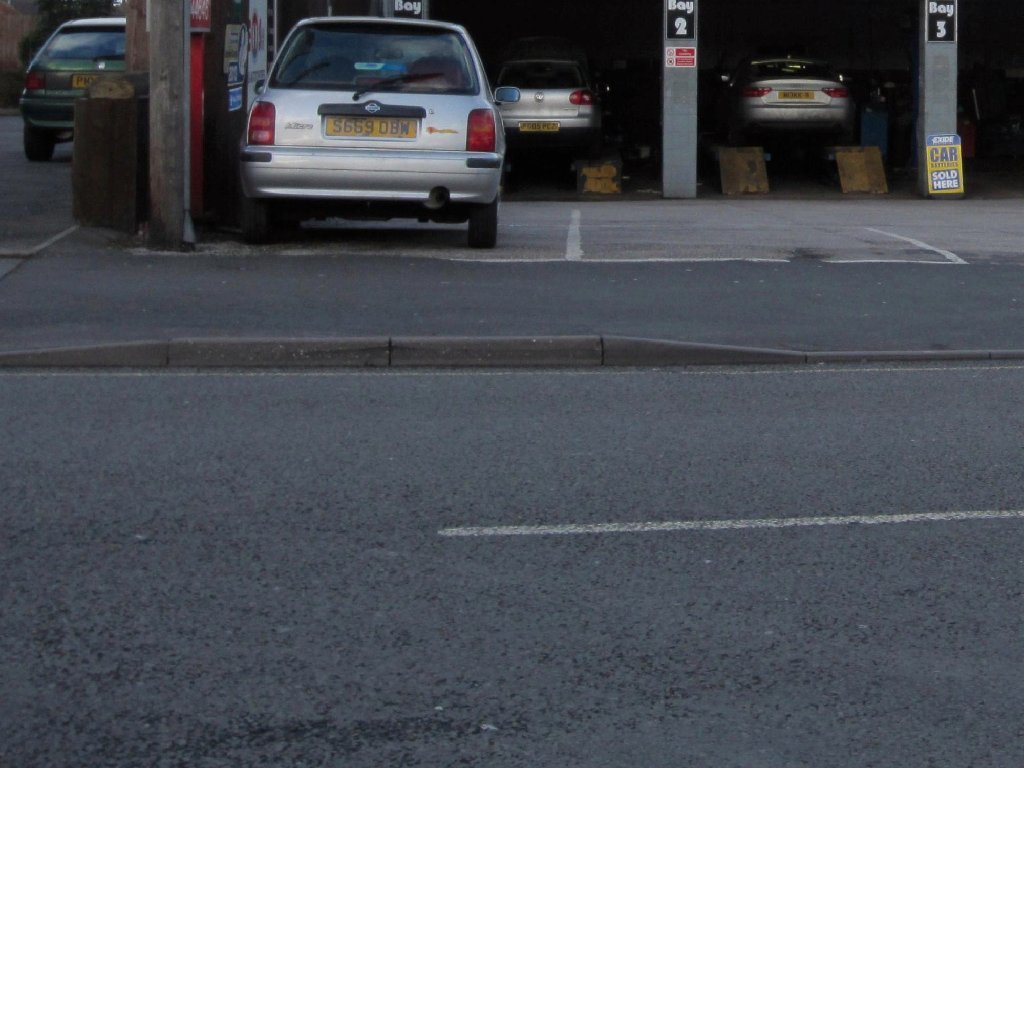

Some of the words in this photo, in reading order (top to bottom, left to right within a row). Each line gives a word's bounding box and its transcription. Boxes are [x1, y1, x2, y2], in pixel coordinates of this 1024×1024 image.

[929, 1, 954, 17] Bay
[674, 17, 687, 35] 2
[936, 21, 946, 37] 3
[930, 147, 958, 162] CAR
[932, 170, 958, 180] SOLD
[933, 179, 959, 190] HERE
